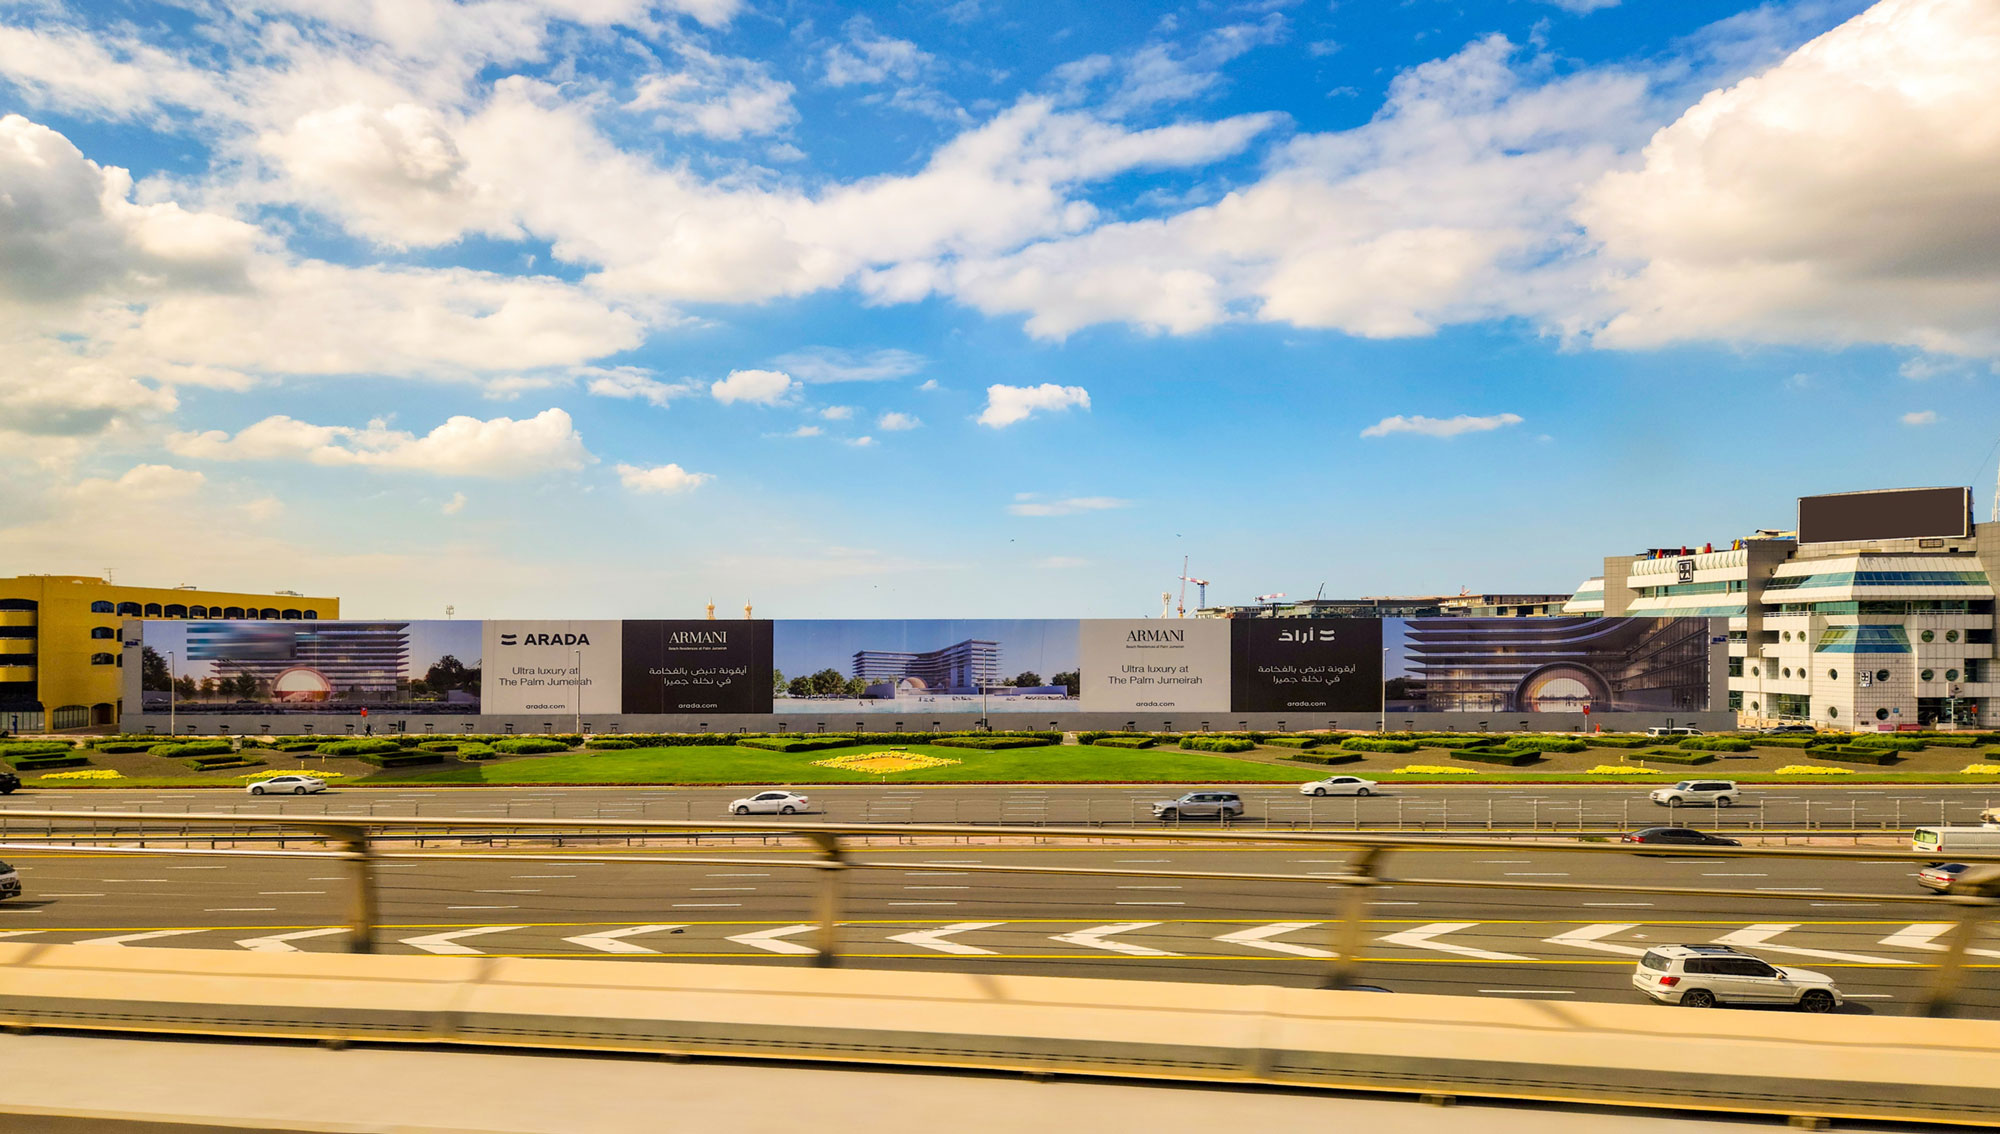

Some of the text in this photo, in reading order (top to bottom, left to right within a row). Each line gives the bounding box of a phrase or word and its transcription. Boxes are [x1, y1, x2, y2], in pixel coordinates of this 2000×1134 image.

[524, 633, 591, 646] ARADA
[668, 631, 728, 644] ARMANI
[1126, 629, 1185, 642] ARMANI
[512, 666, 578, 676] Ultra luxury at
[648, 665, 747, 676] أيقونة تنبض بالفخامة
[1121, 664, 1189, 675] Ultra luxury at
[1257, 663, 1356, 675] أيقونة تنبض بالفخامة
[499, 677, 517, 686] The
[520, 677, 545, 686] Palm
[663, 676, 732, 688] في نخلة جميرا
[1108, 675, 1203, 685] The Palm Jumeirah
[1273, 675, 1341, 686] في نخلة جميرا
